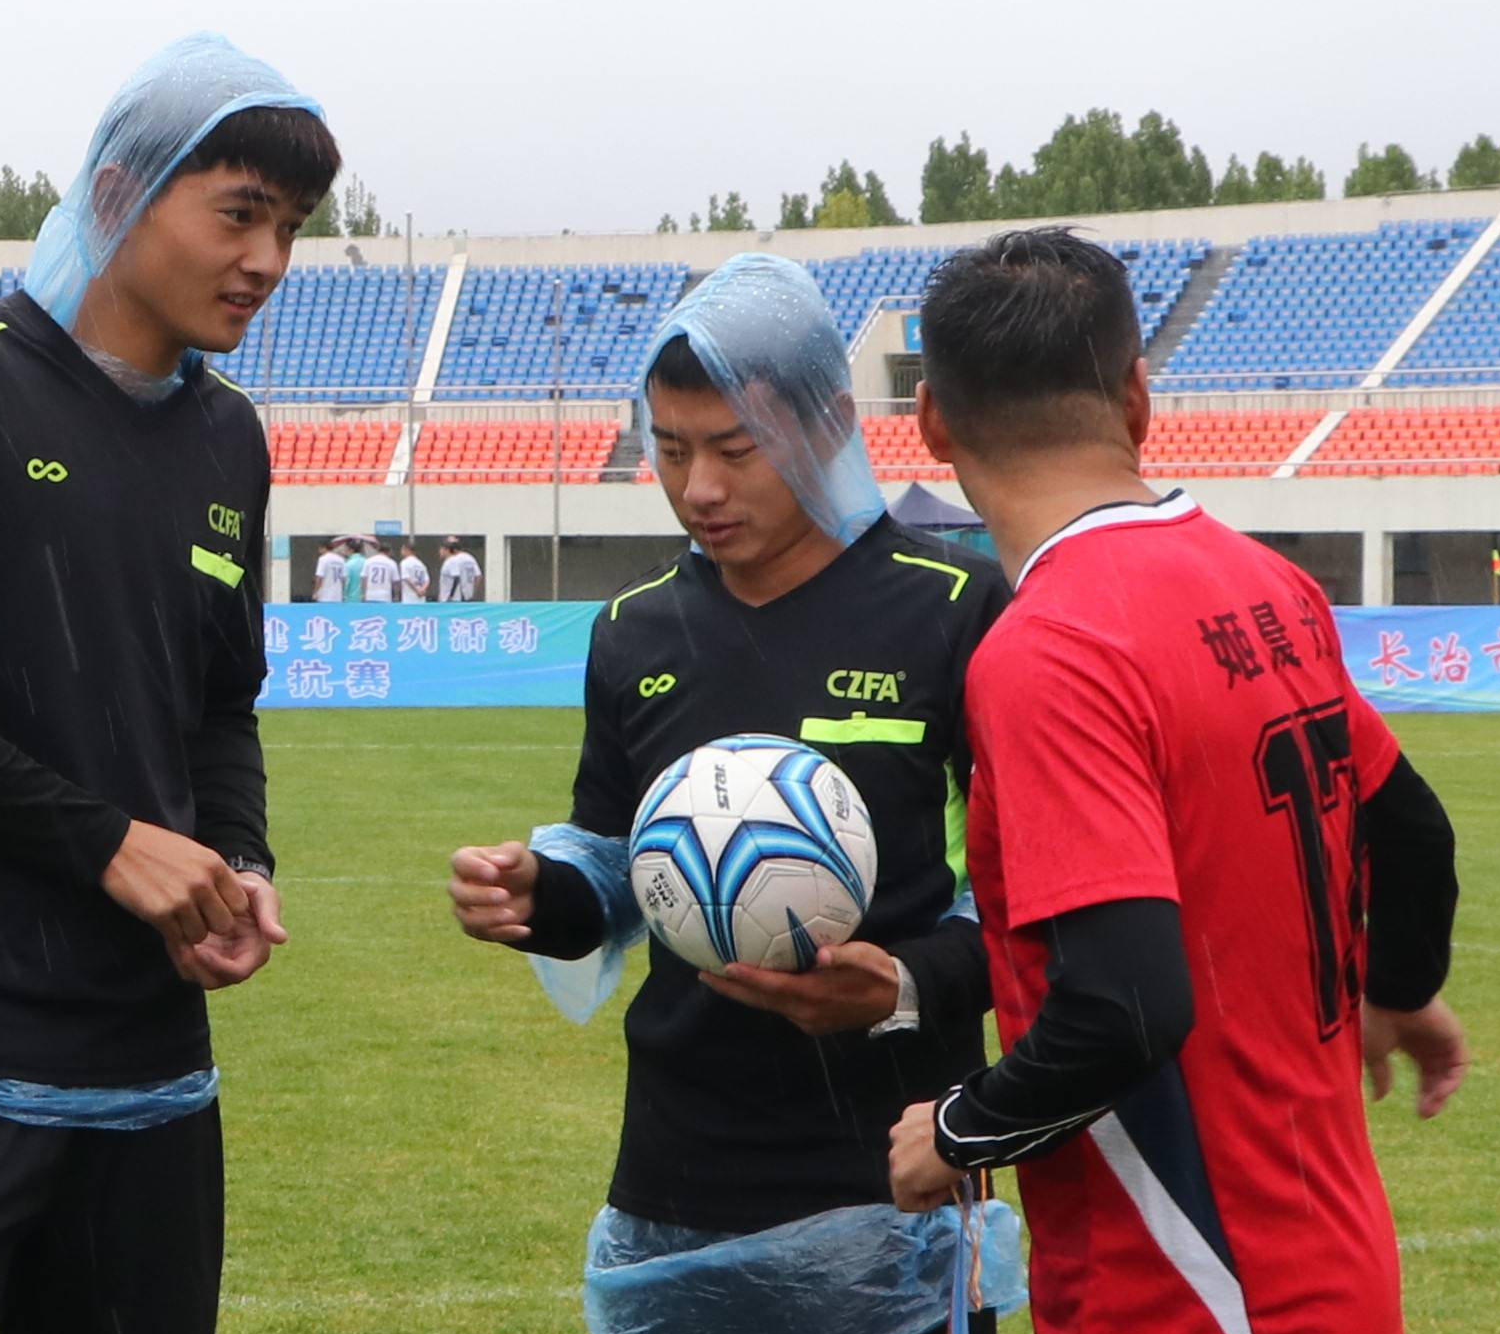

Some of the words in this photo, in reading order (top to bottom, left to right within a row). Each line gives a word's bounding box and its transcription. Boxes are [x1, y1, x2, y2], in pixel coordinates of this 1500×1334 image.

[208, 502, 241, 541] CZFA
[254, 660, 391, 700] 抗赛
[826, 669, 900, 703] CZFA
